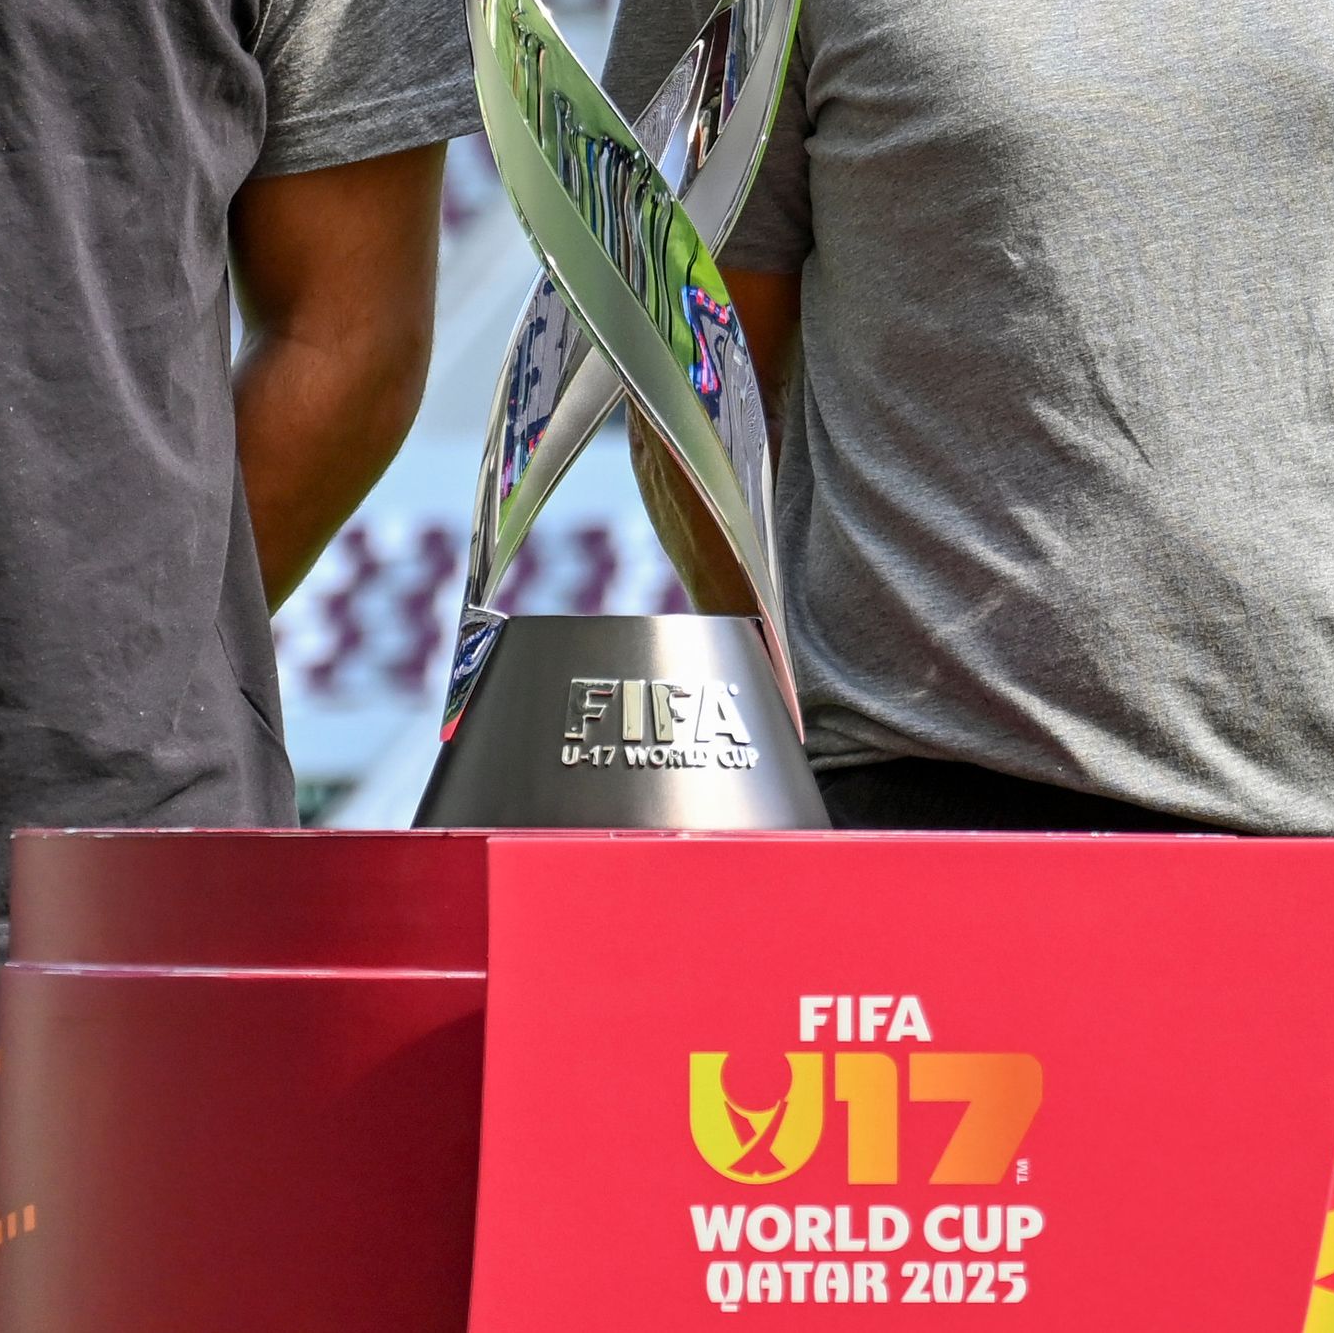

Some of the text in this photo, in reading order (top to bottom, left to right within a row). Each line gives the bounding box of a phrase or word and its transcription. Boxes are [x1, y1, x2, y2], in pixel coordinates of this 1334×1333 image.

[564, 679, 752, 745] FIFA
[562, 745, 760, 770] U-17 WORLD CUP
[800, 996, 931, 1042] FIFA
[689, 1052, 1044, 1184] U17
[690, 1206, 1043, 1253] WORLD CUP
[707, 1261, 1027, 1312] QATAR 2025
